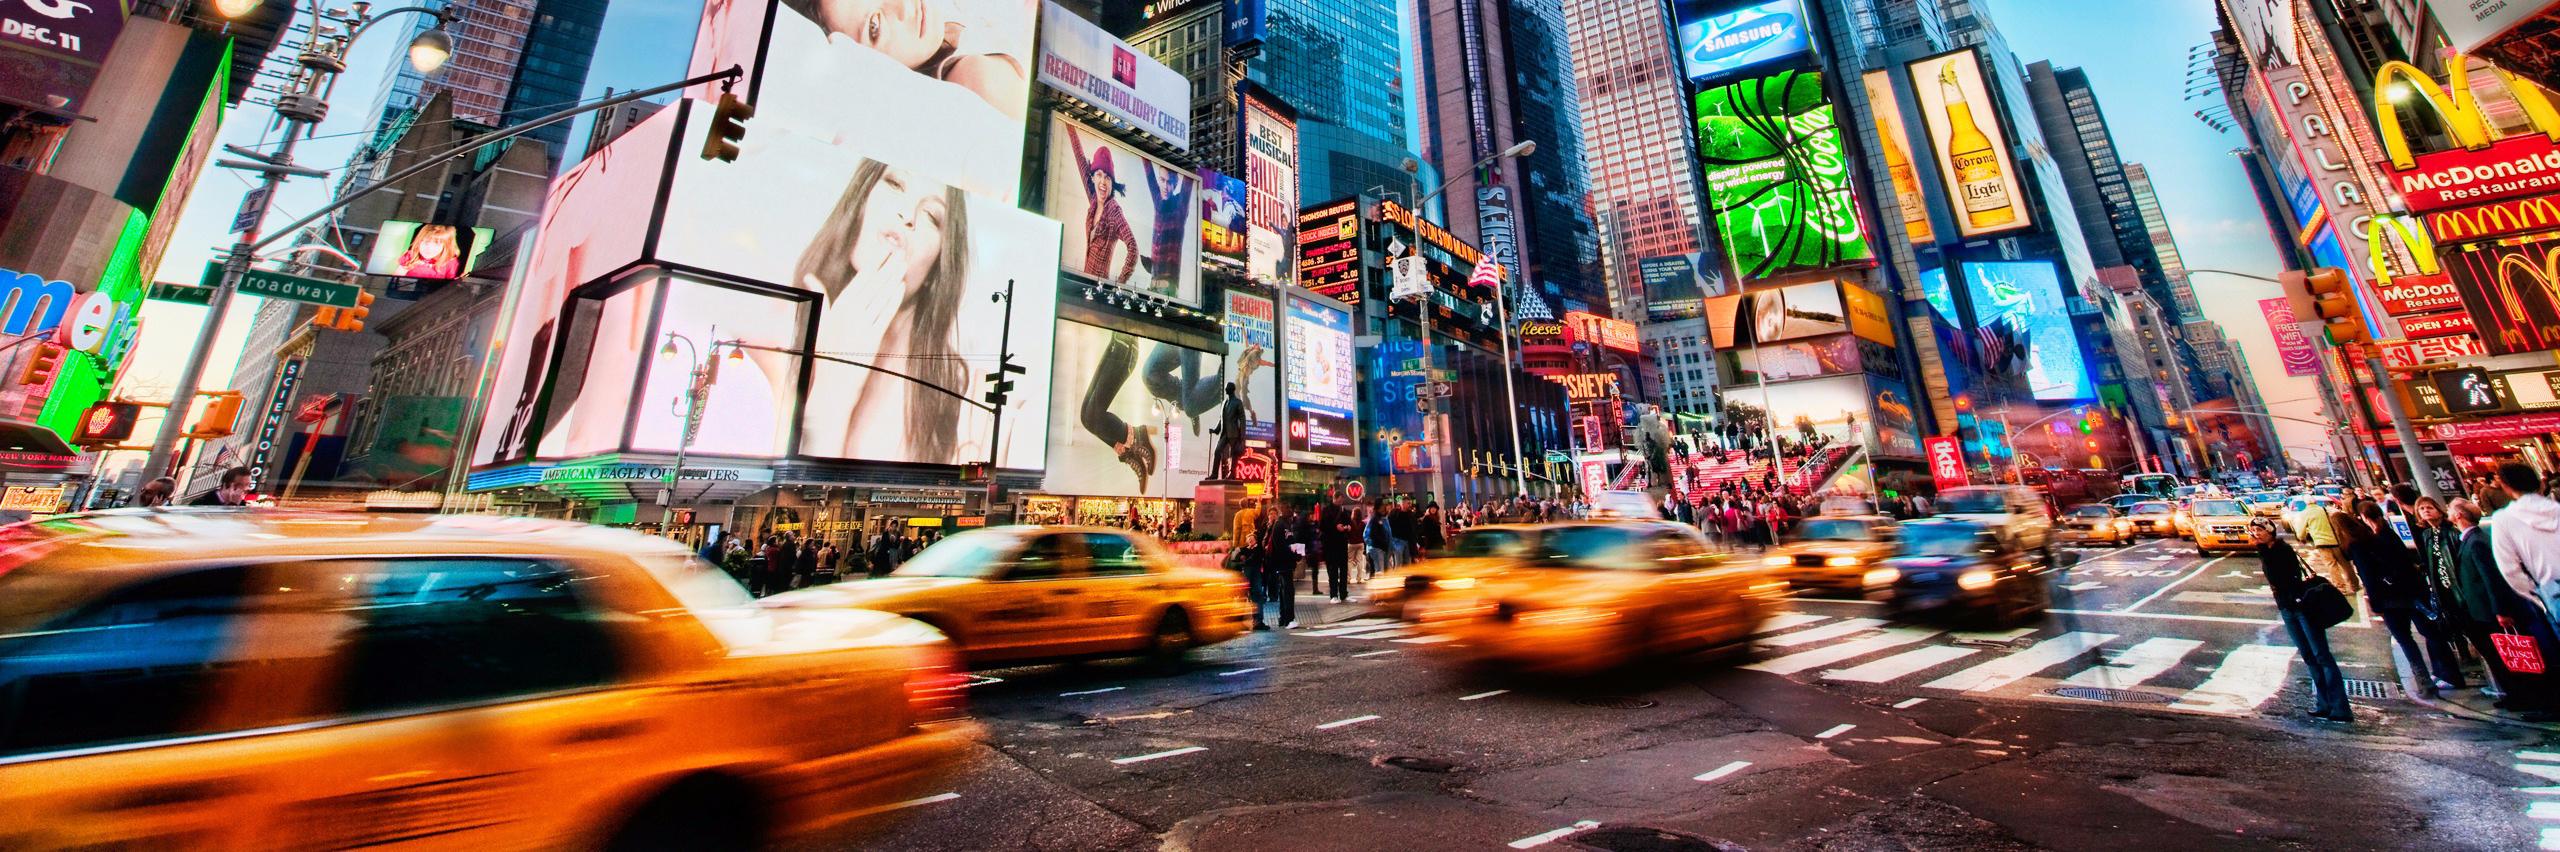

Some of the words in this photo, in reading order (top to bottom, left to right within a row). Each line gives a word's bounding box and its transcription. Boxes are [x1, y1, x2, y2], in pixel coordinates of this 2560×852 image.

[2475, 1, 2507, 22] MEDIA
[1231, 17, 1248, 30] NYC
[2, 17, 57, 45] DEC.
[59, 32, 80, 52] 11
[1705, 22, 1783, 52] SAMSUNG
[1117, 56, 1131, 76] GAP
[1044, 52, 1087, 89] READY
[1088, 74, 1111, 101] FOR
[1111, 86, 1157, 124] HOLIDAY
[1157, 110, 1186, 140] CHEER
[1259, 124, 1282, 148] BEST
[1249, 133, 1292, 168] MUSICAL
[1707, 164, 1741, 182] display
[1742, 157, 1785, 177] powered
[1955, 154, 1994, 171] Corona
[1250, 152, 1279, 199] BILLY
[1713, 179, 1725, 192] by
[1726, 174, 1749, 188] wind
[1750, 170, 1785, 185] energy
[1965, 181, 2002, 199] Light
[1251, 190, 1284, 235] ELLIOT
[1300, 208, 1328, 223] THOMSON
[1329, 202, 1355, 217] REUTERS
[1300, 230, 1318, 242] STOCK
[1318, 226, 1338, 239] INDICES
[1508, 210, 1518, 252] Chocolate
[171, 286, 184, 299] 7
[246, 276, 336, 302] roadway
[1232, 293, 1273, 321] HEIGHTS
[1520, 321, 1562, 335] Reese's
[2275, 322, 2300, 332] FREE
[2405, 321, 2441, 332] OPEN
[2444, 319, 2460, 328] 24
[1229, 325, 1244, 343] BEST
[1247, 327, 1273, 349] MUSICAL
[249, 364, 297, 491] SCIENTOLOG
[1291, 420, 1307, 438] CNN
[1236, 460, 1265, 480] ROXY
[1934, 440, 1956, 479] tkts
[542, 467, 598, 481] AMERICAN
[600, 467, 647, 480] EAGLE
[875, 494, 908, 502] AMERICAN
[2508, 657, 2519, 669] of
